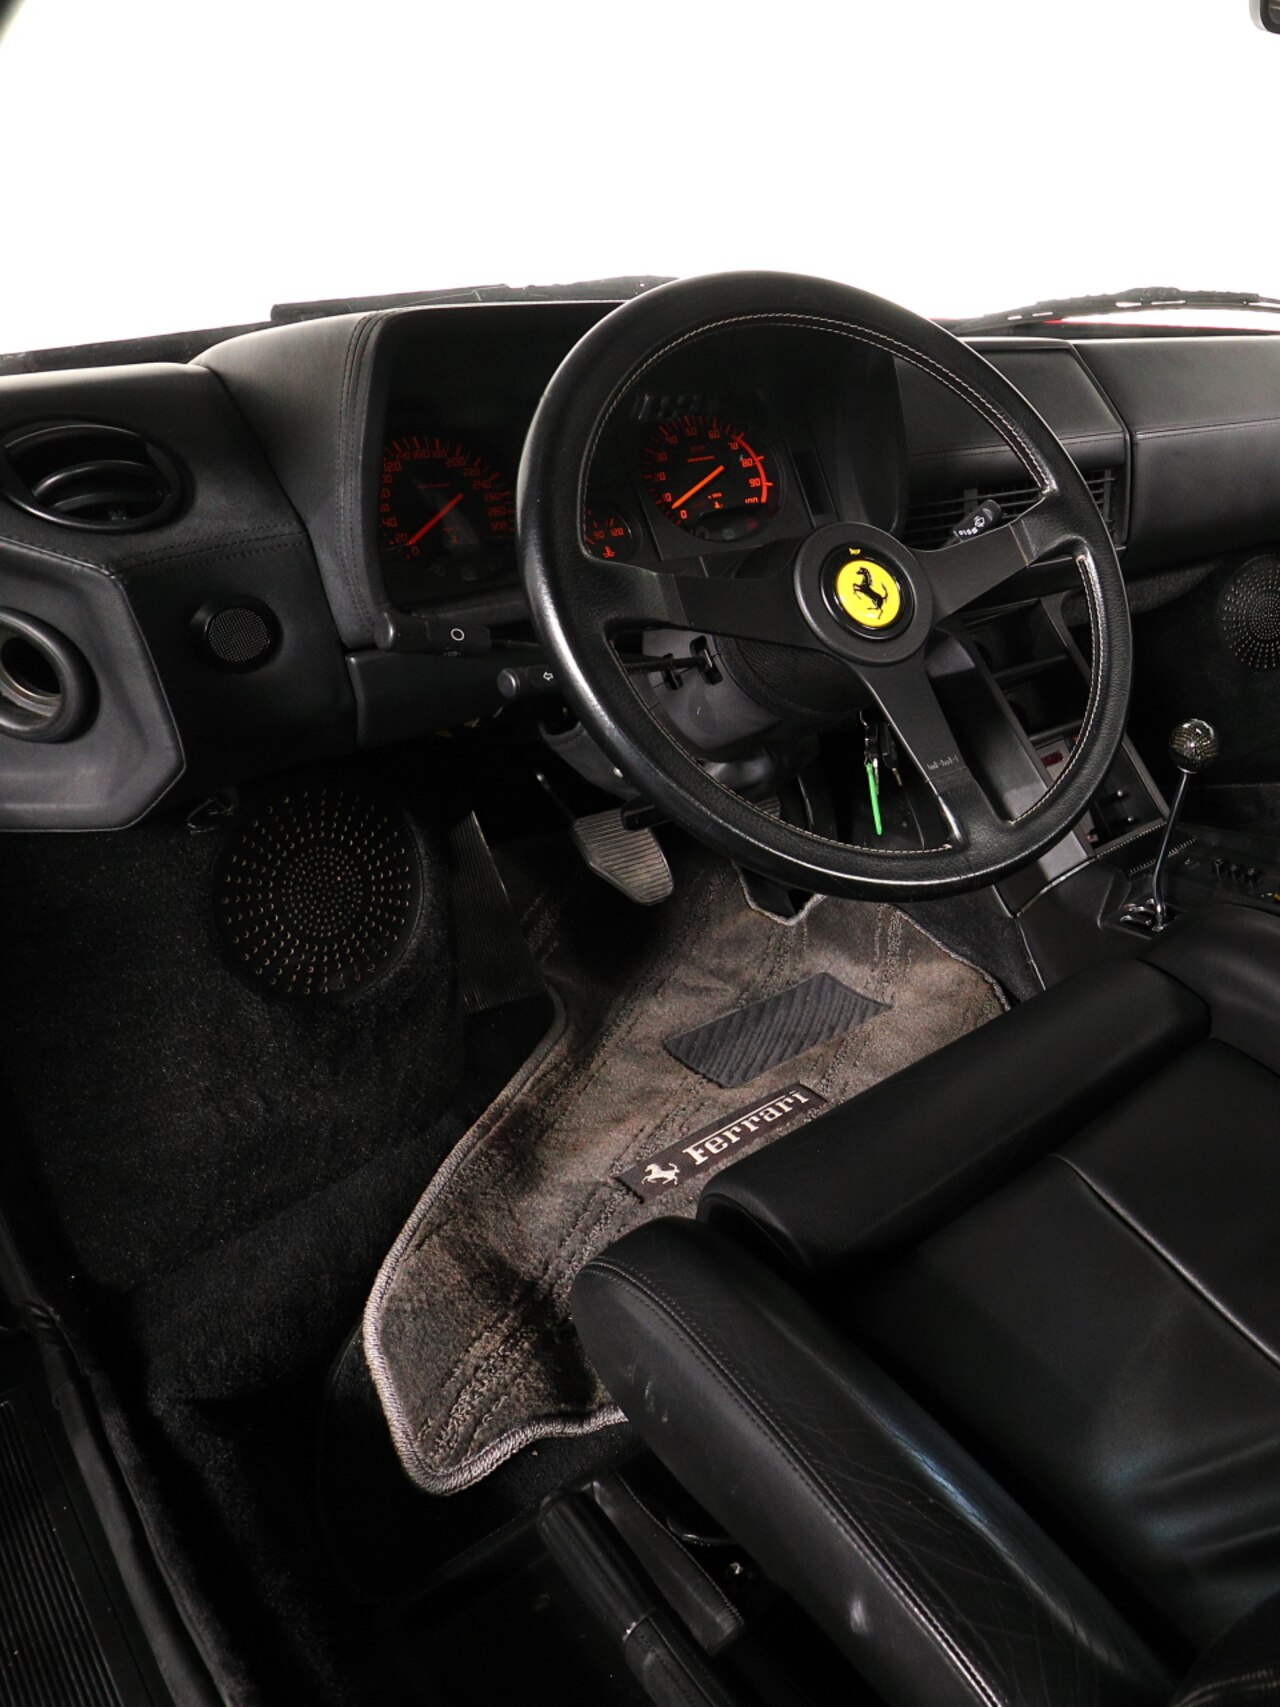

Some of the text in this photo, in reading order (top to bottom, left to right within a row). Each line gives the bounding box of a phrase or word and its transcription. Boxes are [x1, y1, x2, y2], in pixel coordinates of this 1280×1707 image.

[728, 442, 739, 451] 70
[741, 458, 753, 467] 80
[748, 477, 761, 488] 90
[680, 509, 688, 519] 0
[682, 1090, 811, 1166] Ferrari
